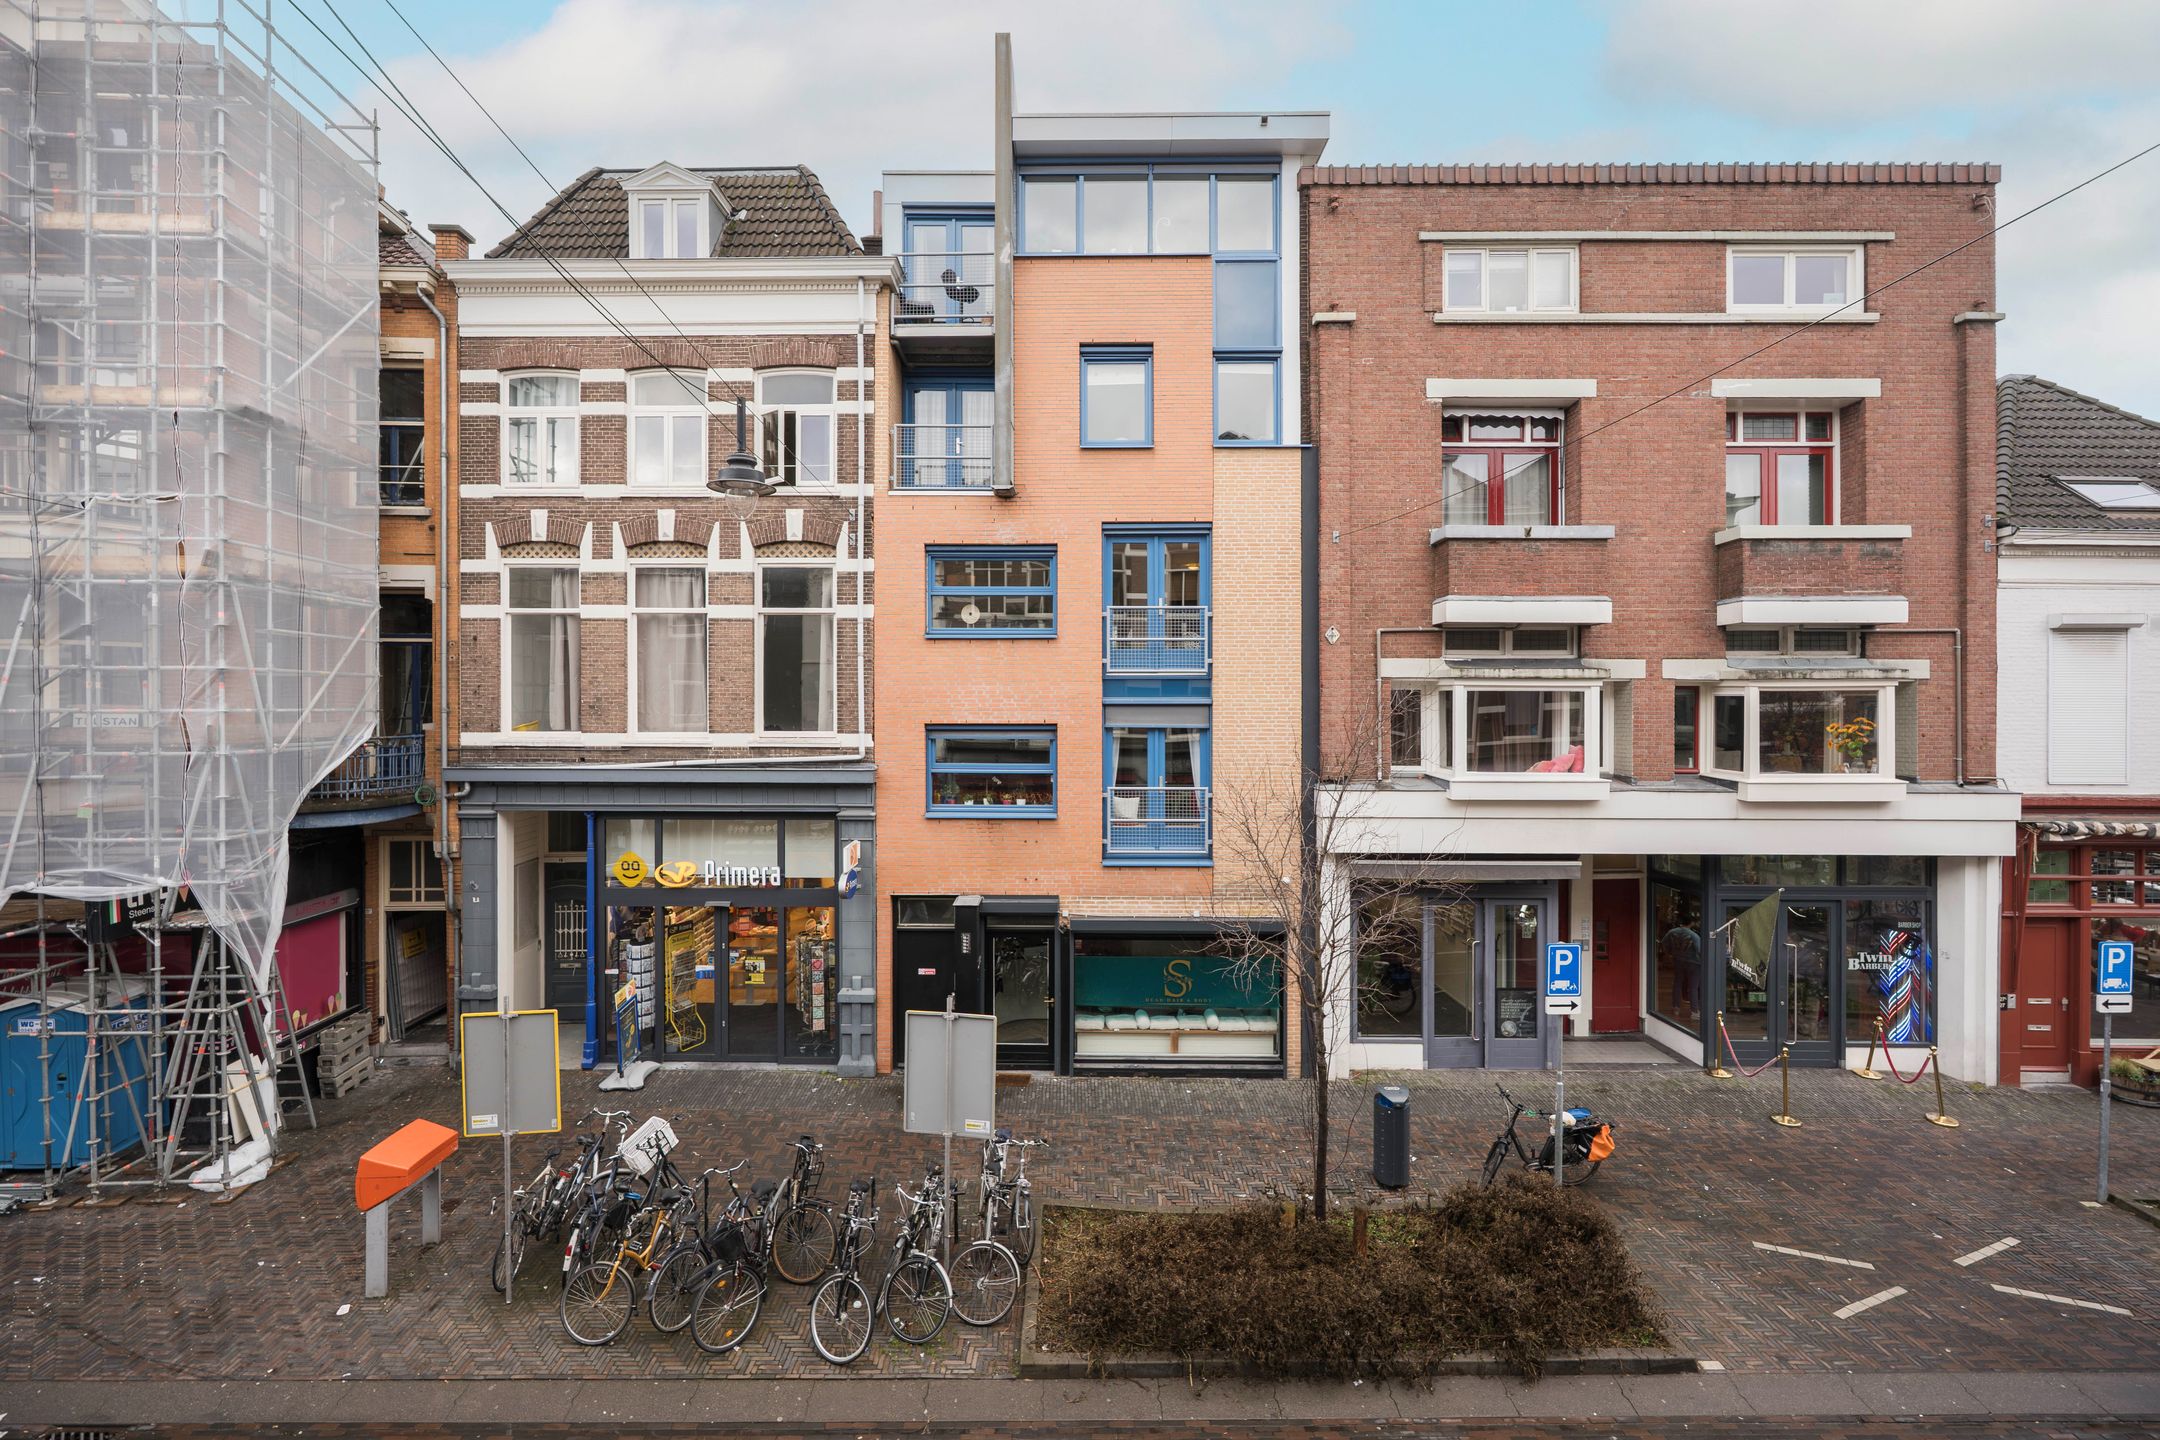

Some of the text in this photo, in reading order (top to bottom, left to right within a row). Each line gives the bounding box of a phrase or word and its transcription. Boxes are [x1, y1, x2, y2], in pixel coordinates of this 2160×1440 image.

[704, 860, 781, 886] Primera
[1555, 949, 1573, 975] P
[1857, 952, 1893, 963] Twin
[2108, 947, 2126, 973] P
